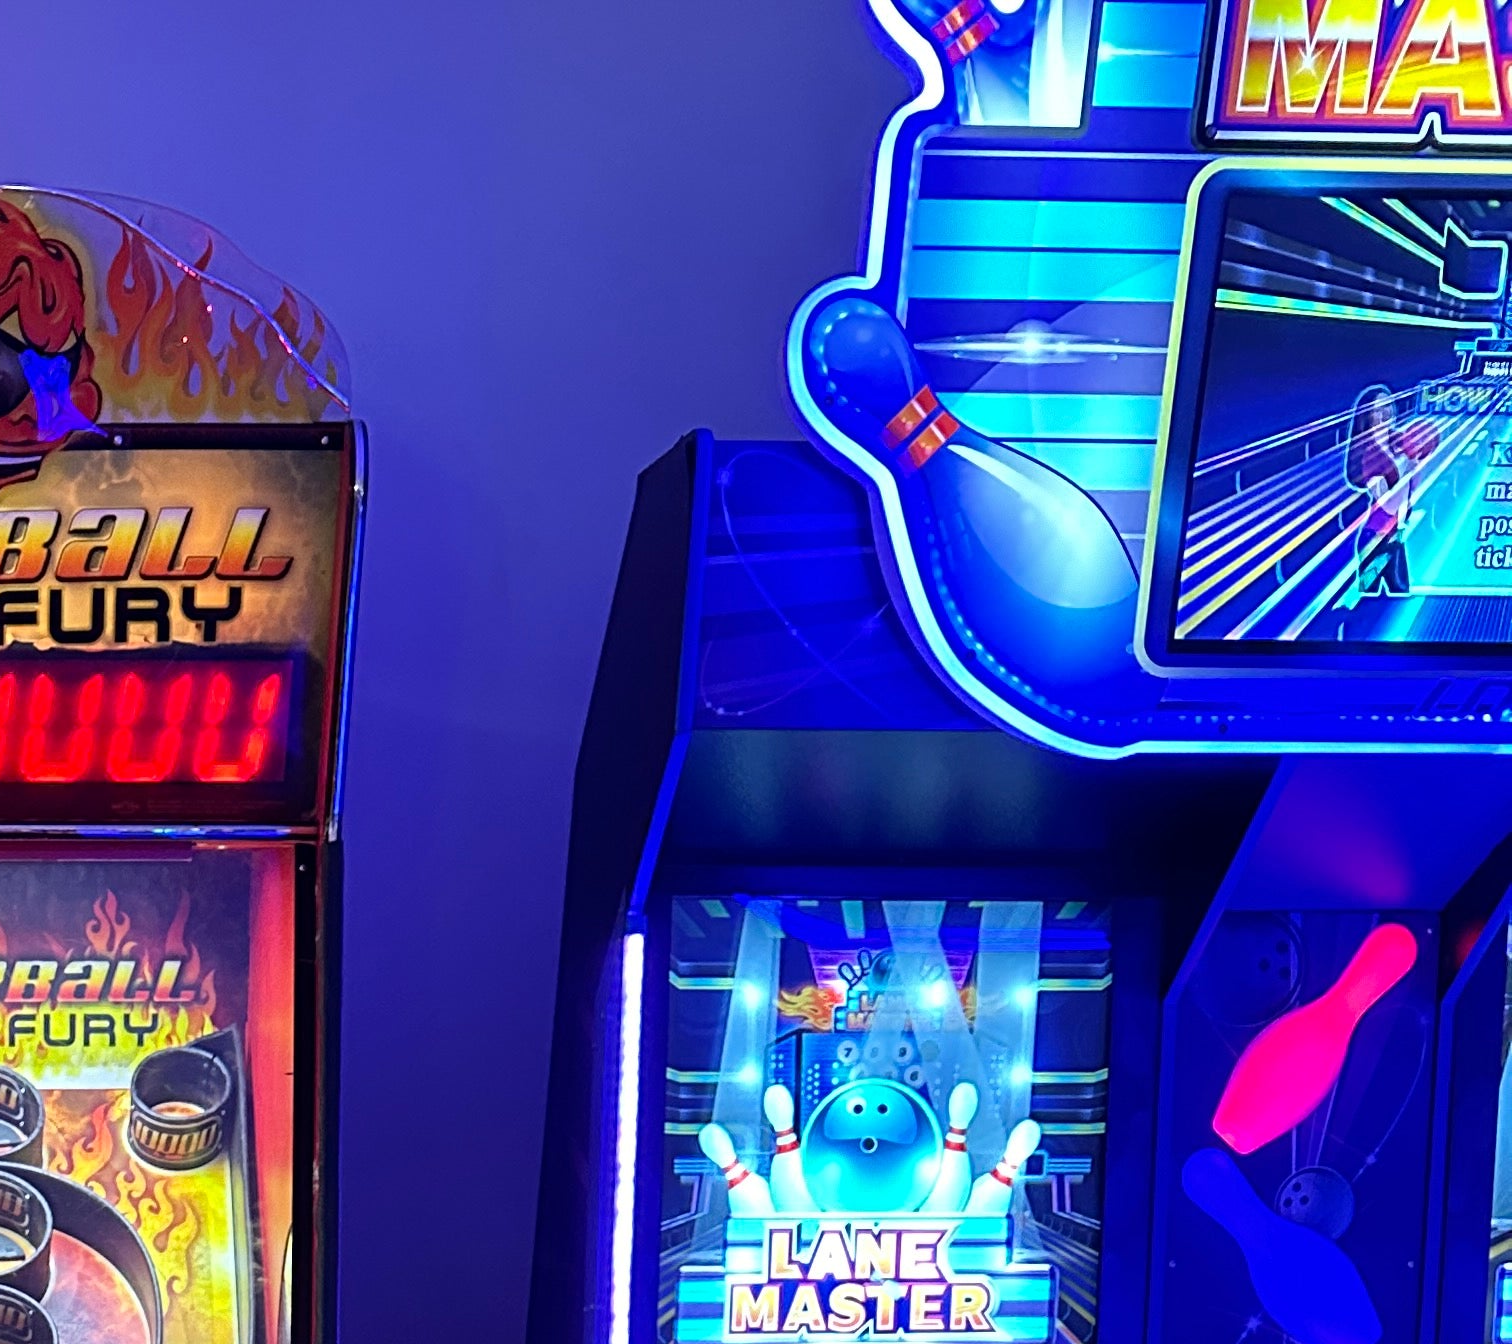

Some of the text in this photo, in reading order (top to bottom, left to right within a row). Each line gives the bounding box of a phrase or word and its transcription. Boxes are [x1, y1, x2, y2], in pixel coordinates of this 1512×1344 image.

[1236, 0, 1512, 115] MA
[8, 1013, 159, 1048] FURY
[135, 1121, 219, 1155] 10000
[770, 1229, 948, 1280] LANE
[731, 1282, 996, 1332] MASTER
